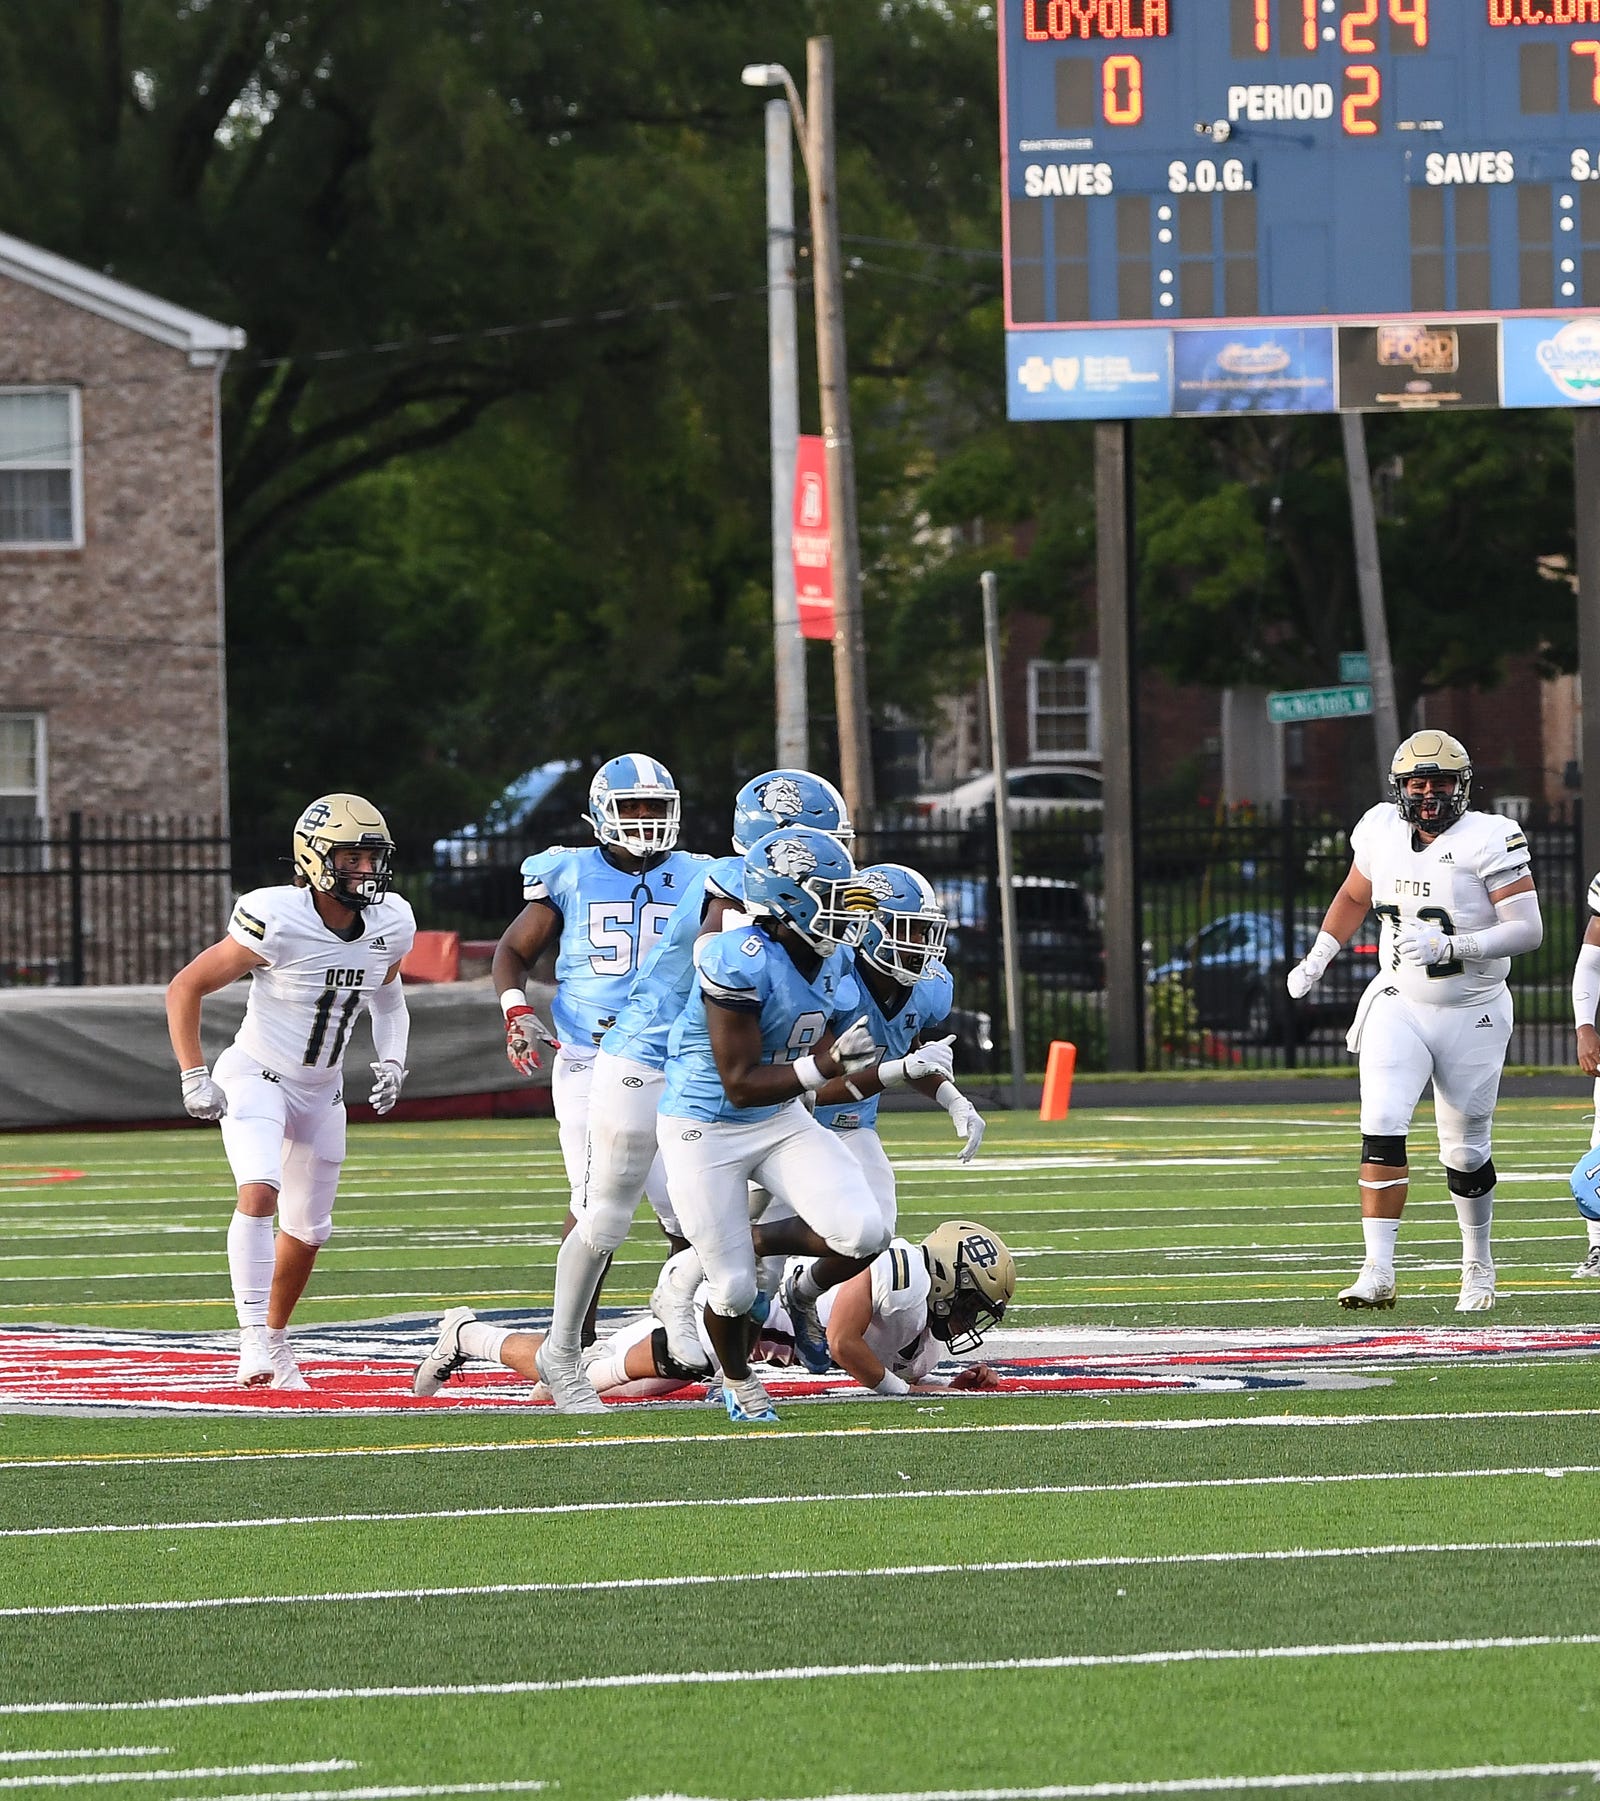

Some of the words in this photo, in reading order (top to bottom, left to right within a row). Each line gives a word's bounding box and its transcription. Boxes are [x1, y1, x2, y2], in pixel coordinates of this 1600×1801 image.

[1025, 0, 1167, 41] LOYOLA
[1102, 55, 1143, 124] 0
[1228, 83, 1334, 121] PERIOD
[1341, 65, 1381, 134] 2
[1024, 163, 1113, 197] SAVES
[1168, 159, 1253, 193] S.O.G.
[1425, 151, 1514, 185] SAVES
[740, 934, 765, 957] 8
[325, 968, 366, 987] DCDS
[303, 988, 362, 1069] 11
